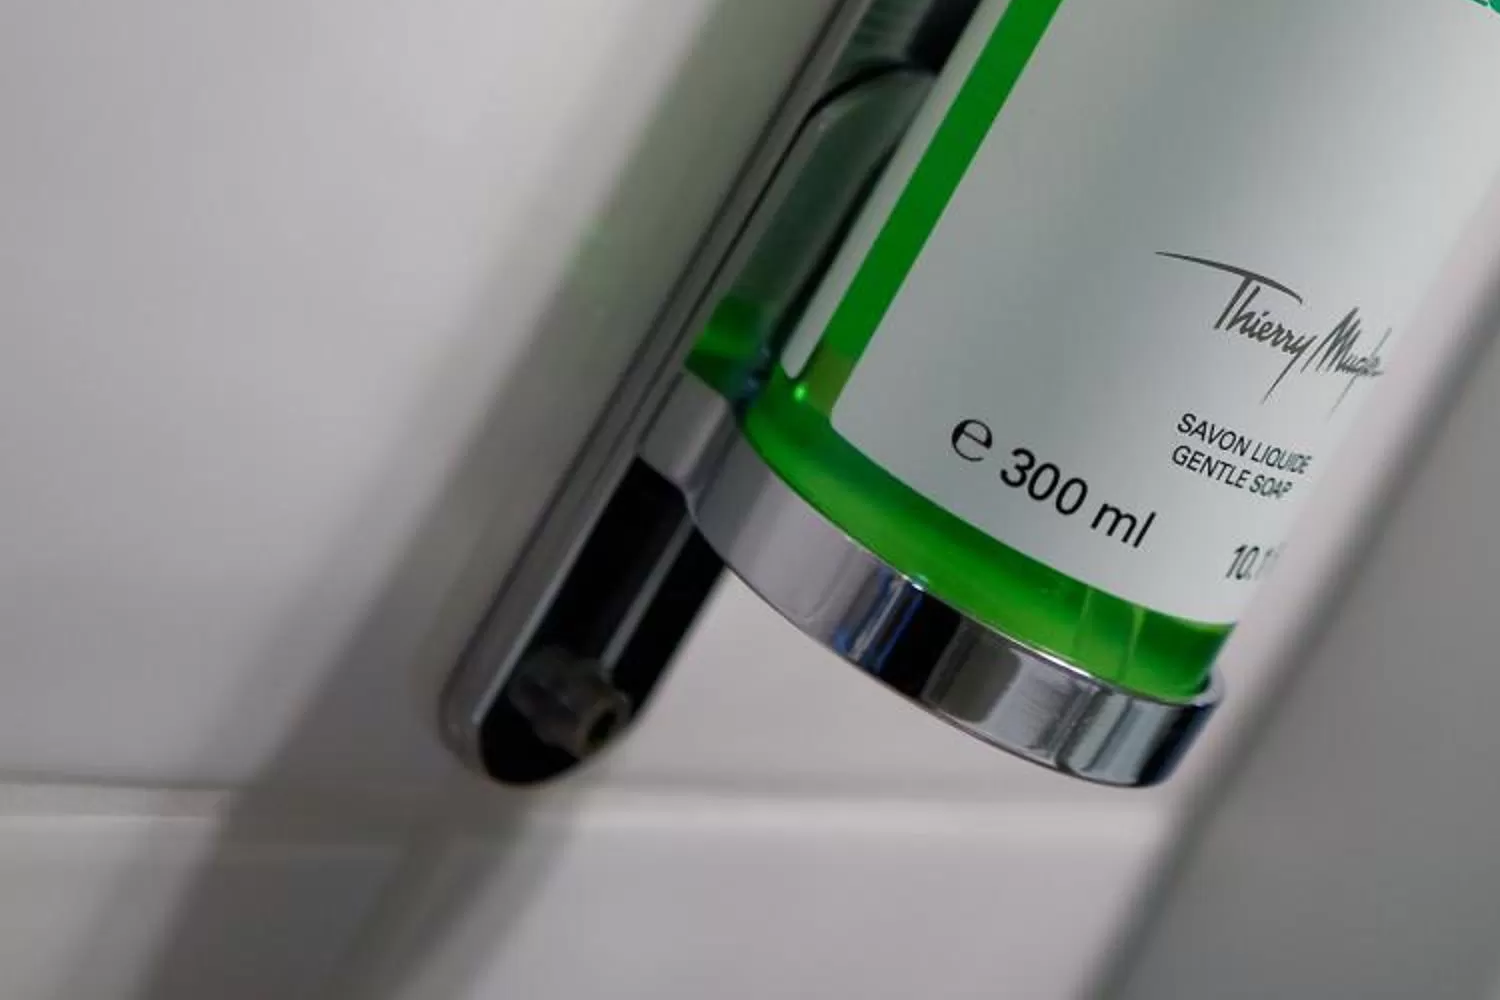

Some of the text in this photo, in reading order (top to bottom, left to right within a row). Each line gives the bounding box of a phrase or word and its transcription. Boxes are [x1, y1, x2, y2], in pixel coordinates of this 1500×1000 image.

[1155, 250, 1317, 404] Thierry
[1172, 444, 1294, 499] GENTLE SOAP
[1177, 412, 1252, 456] SAVON
[1000, 447, 1089, 516] 300
[1090, 502, 1157, 548] ml
